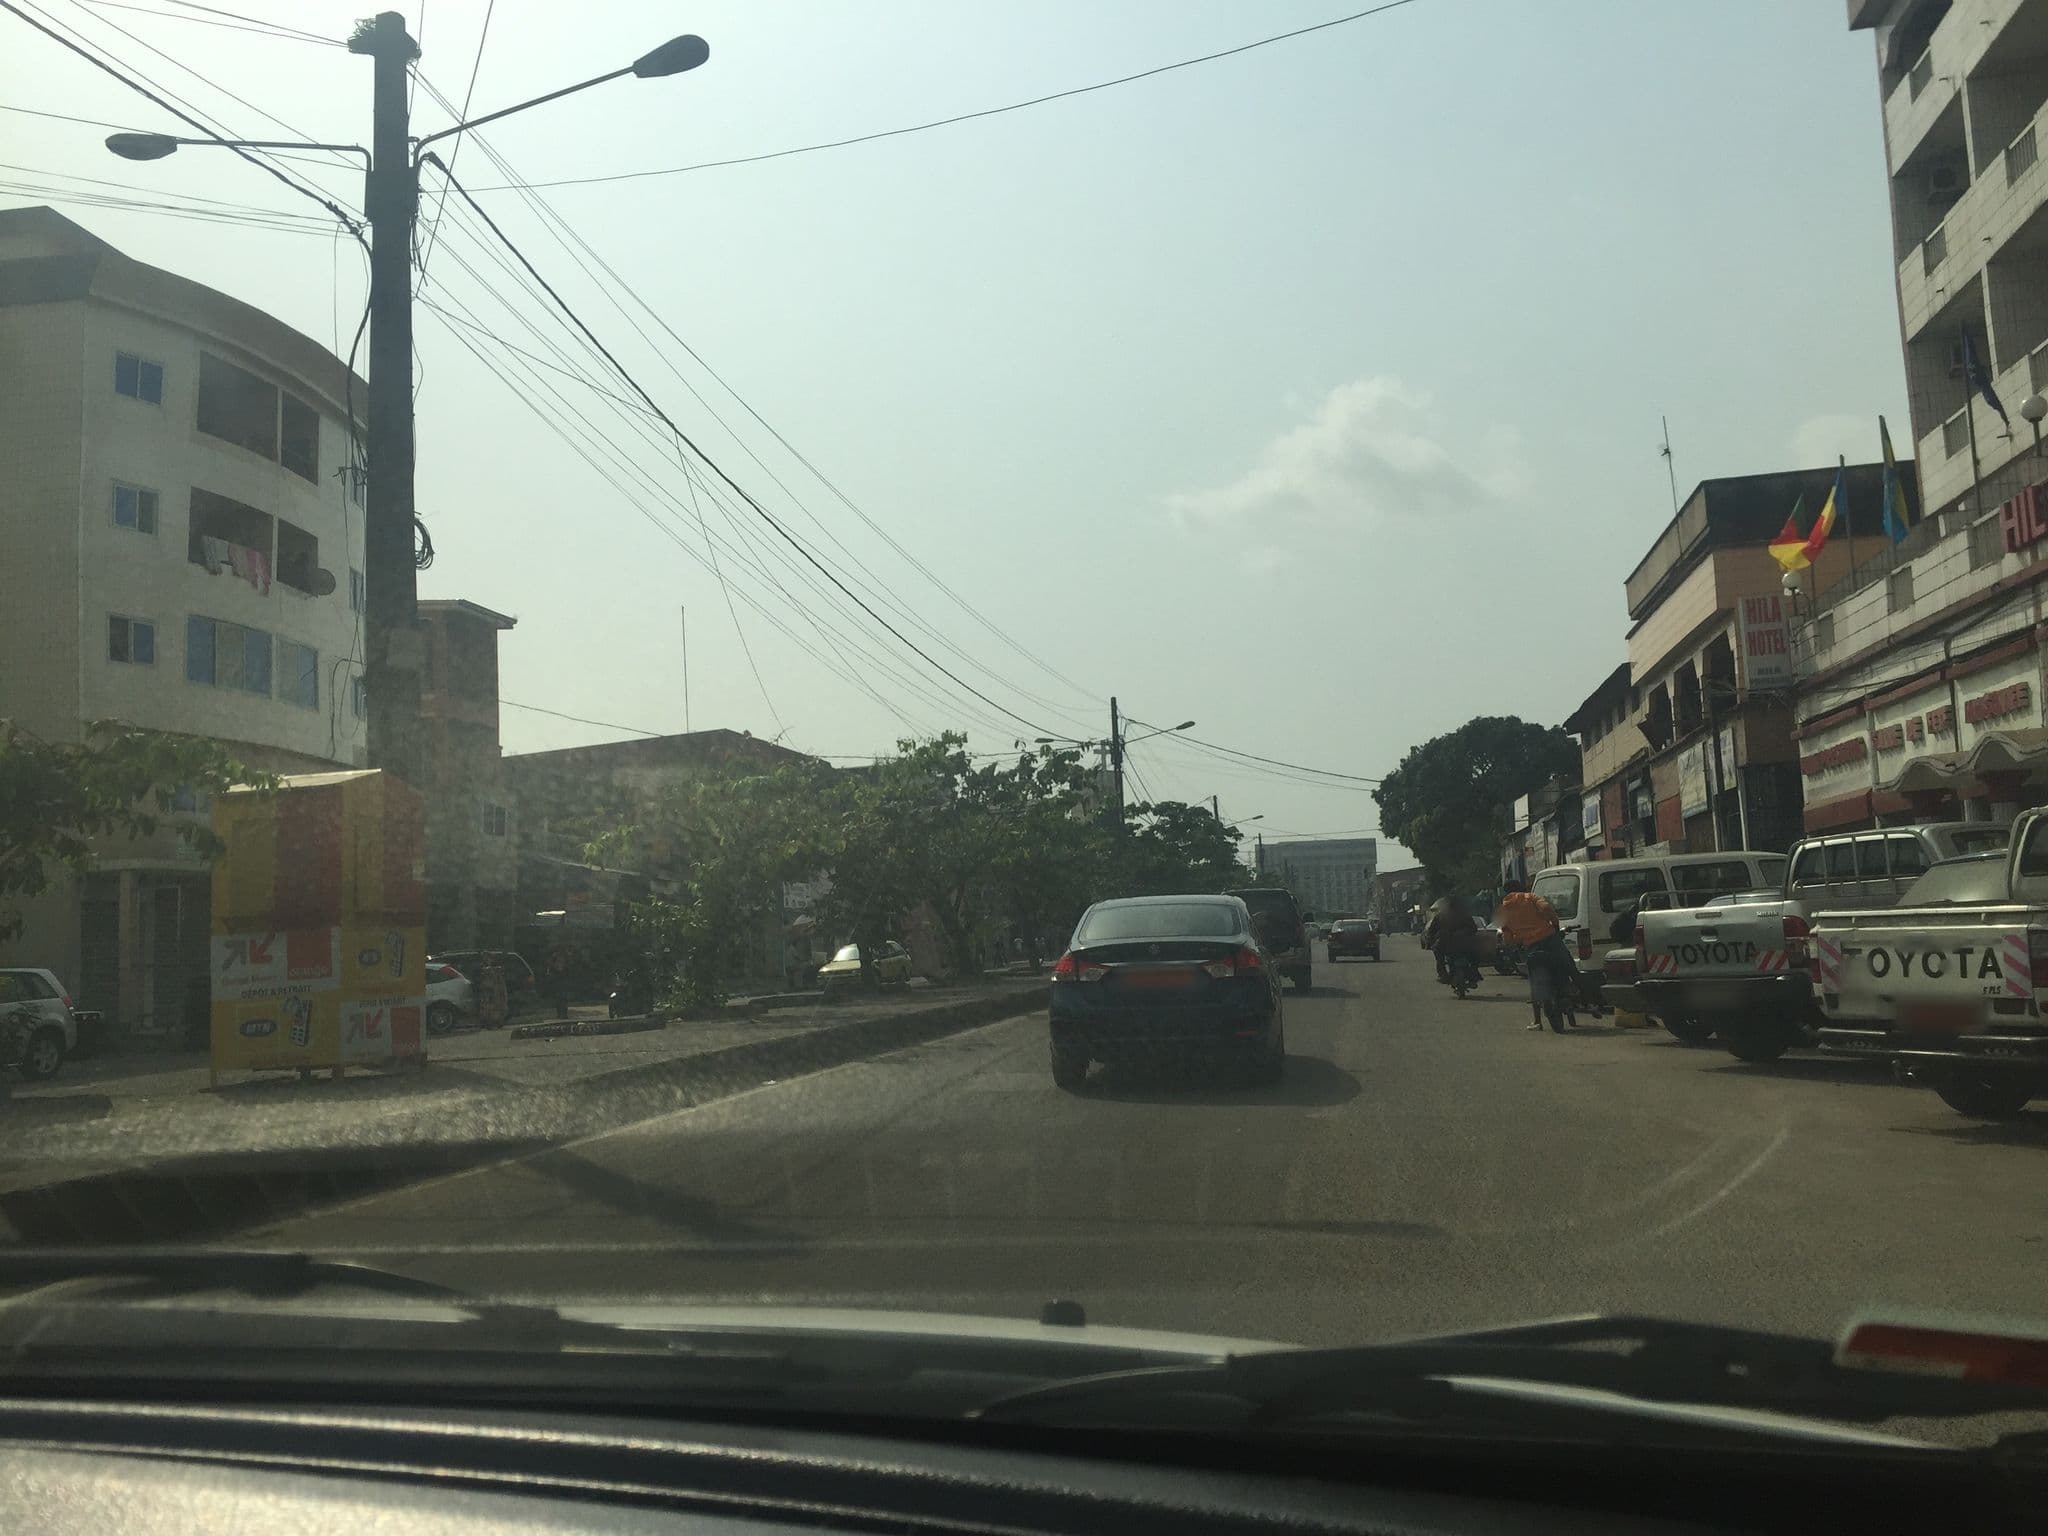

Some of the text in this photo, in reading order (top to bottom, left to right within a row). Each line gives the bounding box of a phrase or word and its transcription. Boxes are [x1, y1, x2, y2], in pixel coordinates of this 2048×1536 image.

[1747, 629, 1787, 656] HOTEL
[1667, 941, 1758, 966] TOYOTA
[1842, 946, 2004, 979] TOYOTA
